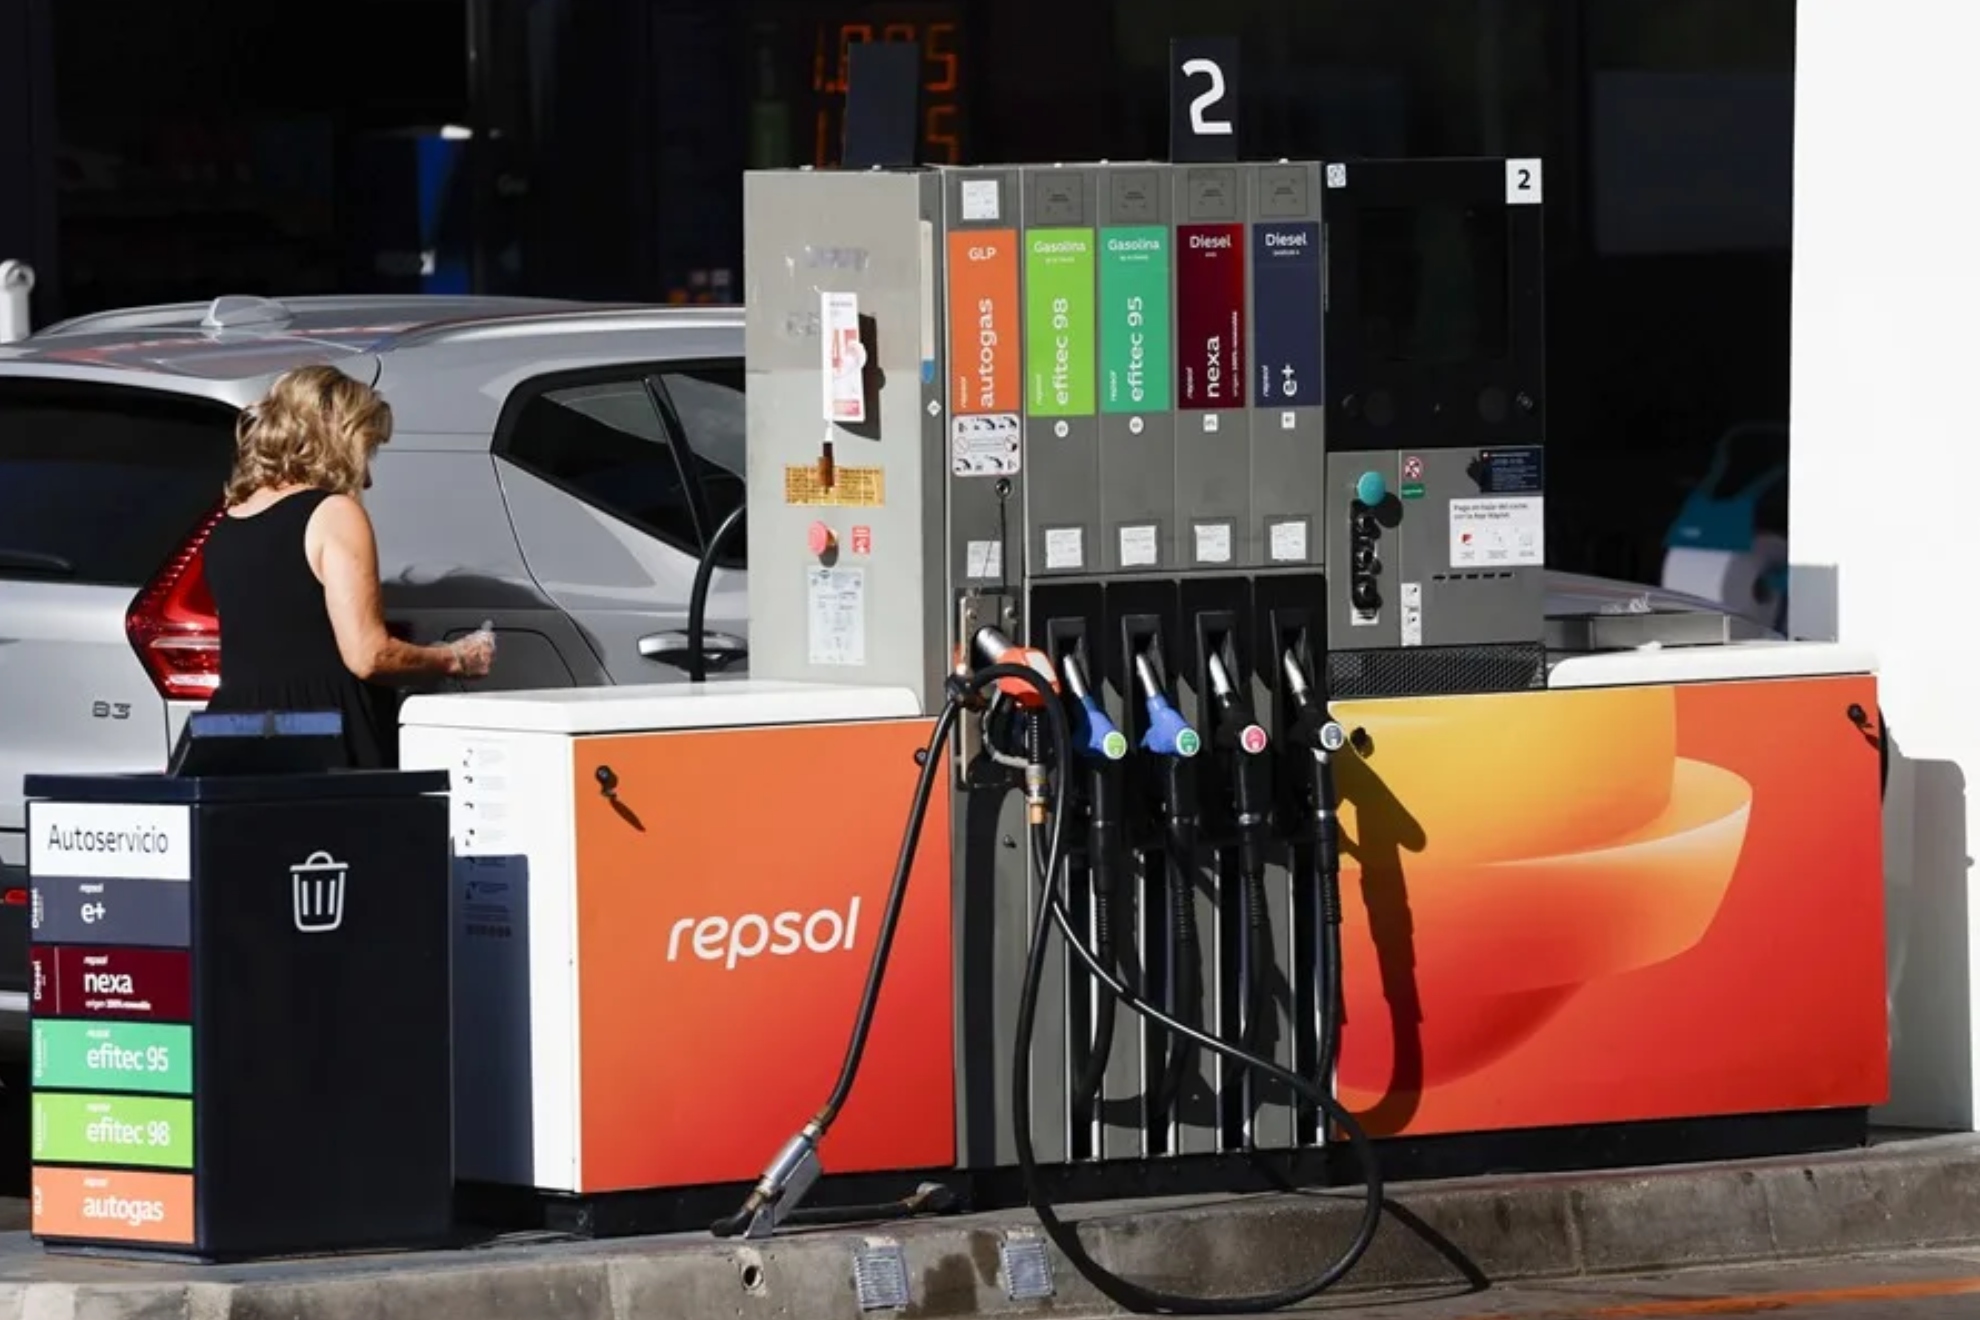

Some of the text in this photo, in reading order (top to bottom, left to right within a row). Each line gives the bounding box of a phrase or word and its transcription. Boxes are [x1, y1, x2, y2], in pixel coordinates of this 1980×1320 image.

[1181, 58, 1234, 135] 2
[1518, 168, 1531, 190] 2
[967, 246, 997, 261] GLP
[1034, 241, 1086, 253] Gasolina
[1107, 238, 1160, 251] Gasolina
[1189, 234, 1232, 248] Diesel
[1264, 231, 1307, 246] Diesel
[1052, 297, 1069, 330] 98
[978, 297, 997, 408] autogas
[1127, 296, 1144, 402] efitec 95
[1052, 335, 1069, 406] efitec
[1207, 336, 1220, 398] nexa
[1281, 363, 1298, 397] e+
[93, 700, 131, 719] B3
[48, 824, 169, 853] Autoservicio
[80, 902, 106, 924] e+
[667, 896, 861, 970] repsol
[84, 972, 134, 994] nexa
[86, 1042, 169, 1072] efitec 95
[86, 1117, 171, 1147] efitec 98
[83, 1196, 164, 1227] autogas
